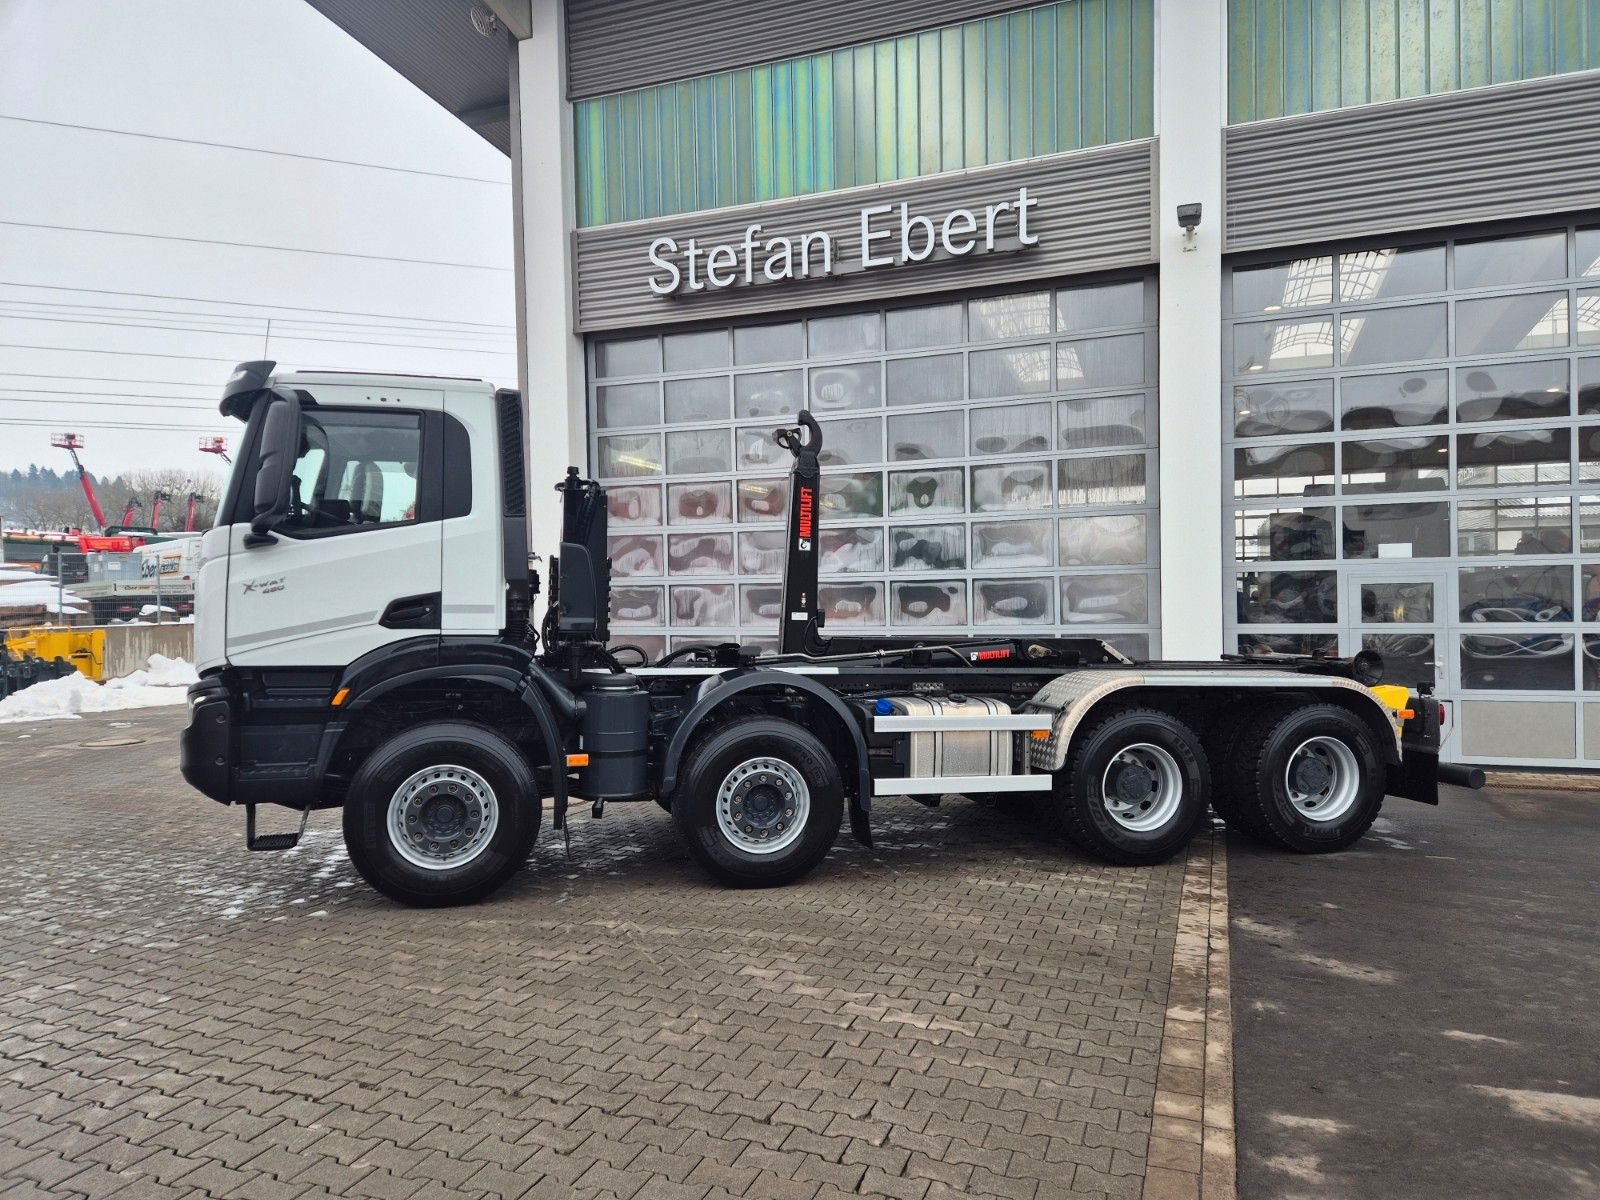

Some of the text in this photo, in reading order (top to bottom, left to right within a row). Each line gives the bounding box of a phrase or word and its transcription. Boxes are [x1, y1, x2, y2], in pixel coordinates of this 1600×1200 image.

[648, 187, 1040, 296] Stefan Ebert
[800, 487, 812, 537] MULTILIFT
[979, 649, 1010, 660] MULTILIFT
